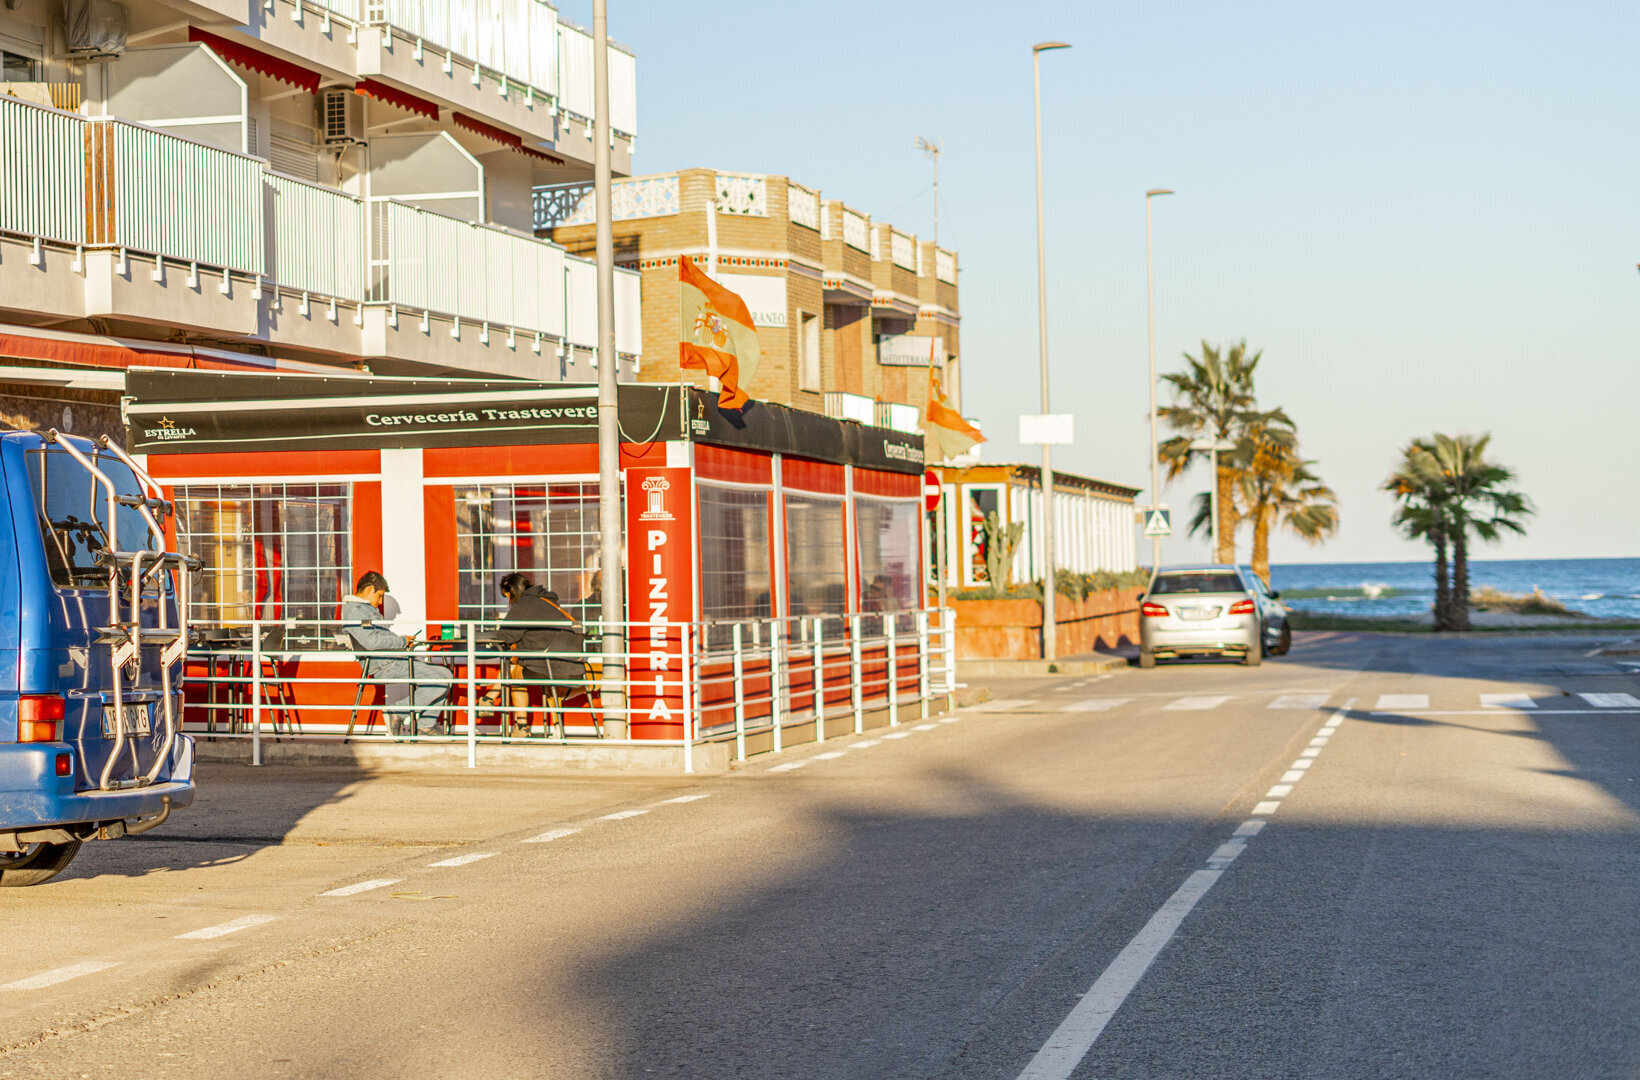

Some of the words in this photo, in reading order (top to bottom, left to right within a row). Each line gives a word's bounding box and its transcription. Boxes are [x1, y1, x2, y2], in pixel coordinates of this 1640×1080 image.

[366, 410, 478, 426] Cervecería
[482, 406, 598, 421] Trastevere
[144, 428, 197, 437] ESTRELLA
[647, 530, 672, 720] PIZZERIA
